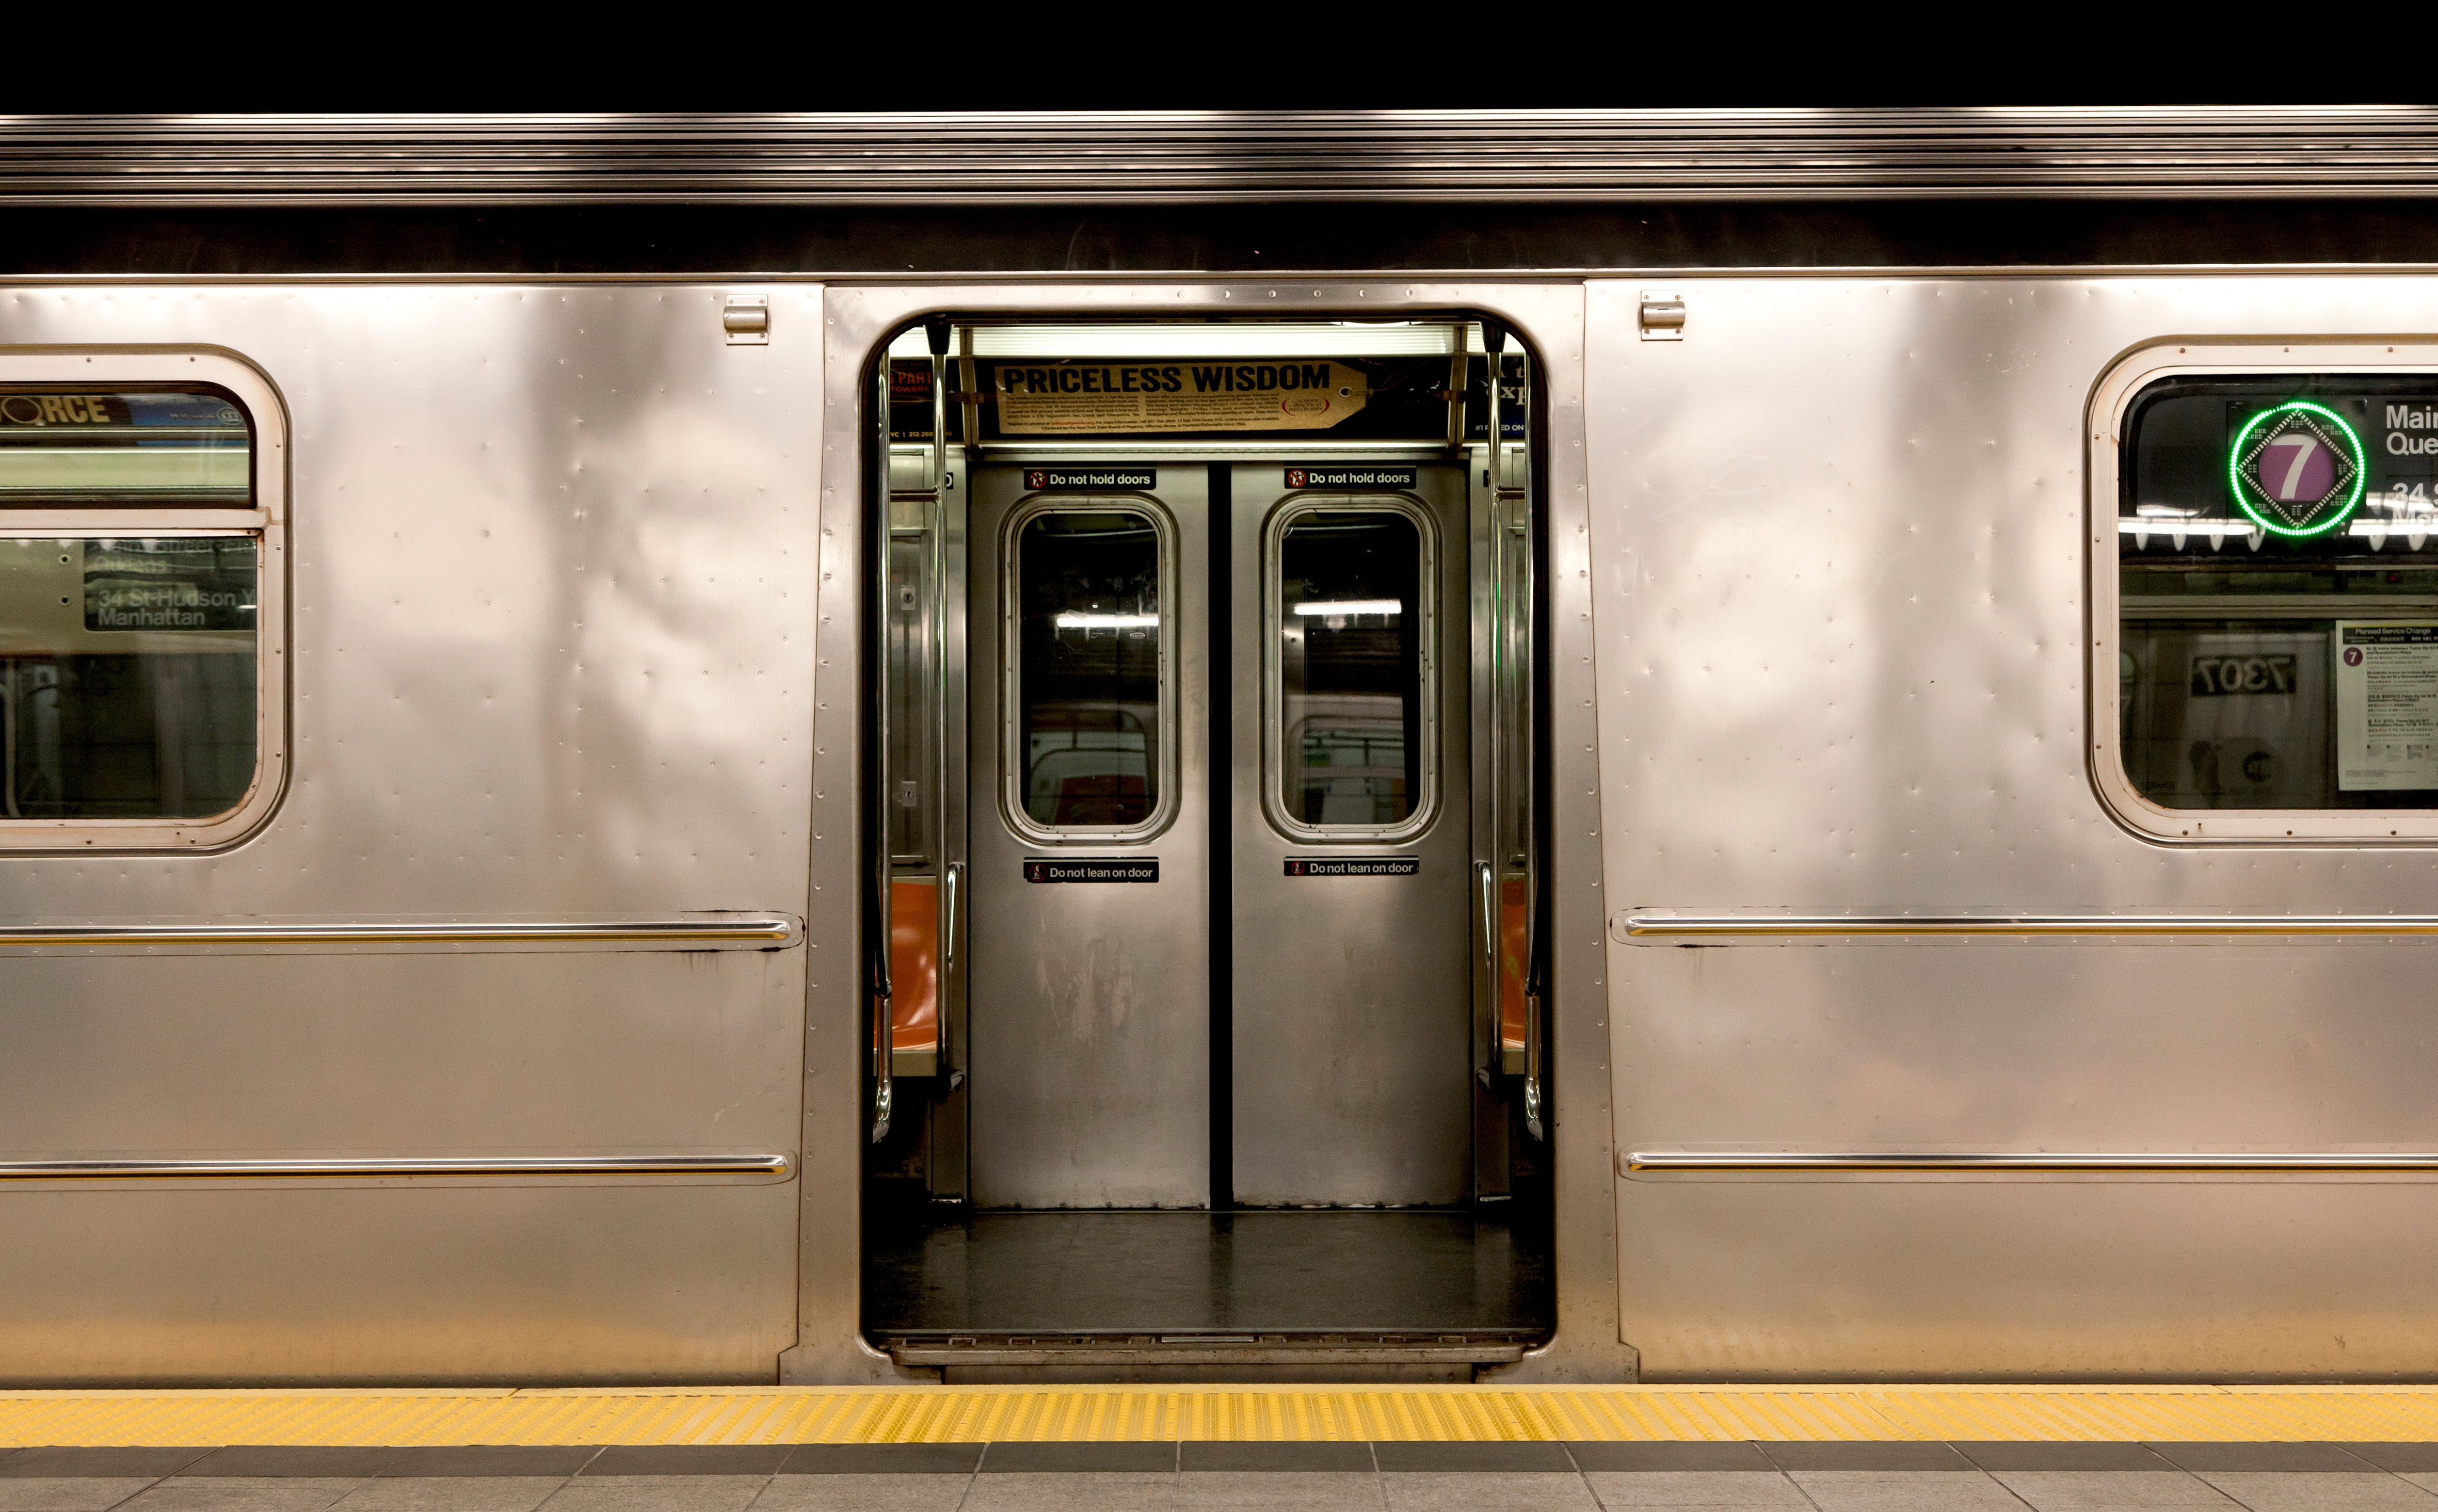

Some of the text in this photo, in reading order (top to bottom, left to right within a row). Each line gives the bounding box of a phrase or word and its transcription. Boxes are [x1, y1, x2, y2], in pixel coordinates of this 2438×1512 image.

[1003, 364, 1330, 394] PRICELESS WISDOM
[2269, 433, 2319, 500] 7
[1050, 474, 1150, 484] Do not hold doors
[1310, 473, 1409, 483] Do not hold doors
[98, 589, 125, 607] 34
[98, 608, 206, 626] Manhattan
[2349, 652, 2357, 664] 7
[1050, 868, 1065, 877] Do
[1067, 868, 1085, 877] not
[1088, 868, 1110, 877] lean
[1128, 868, 1152, 877] door
[1310, 862, 1413, 873] Do not lean on door
